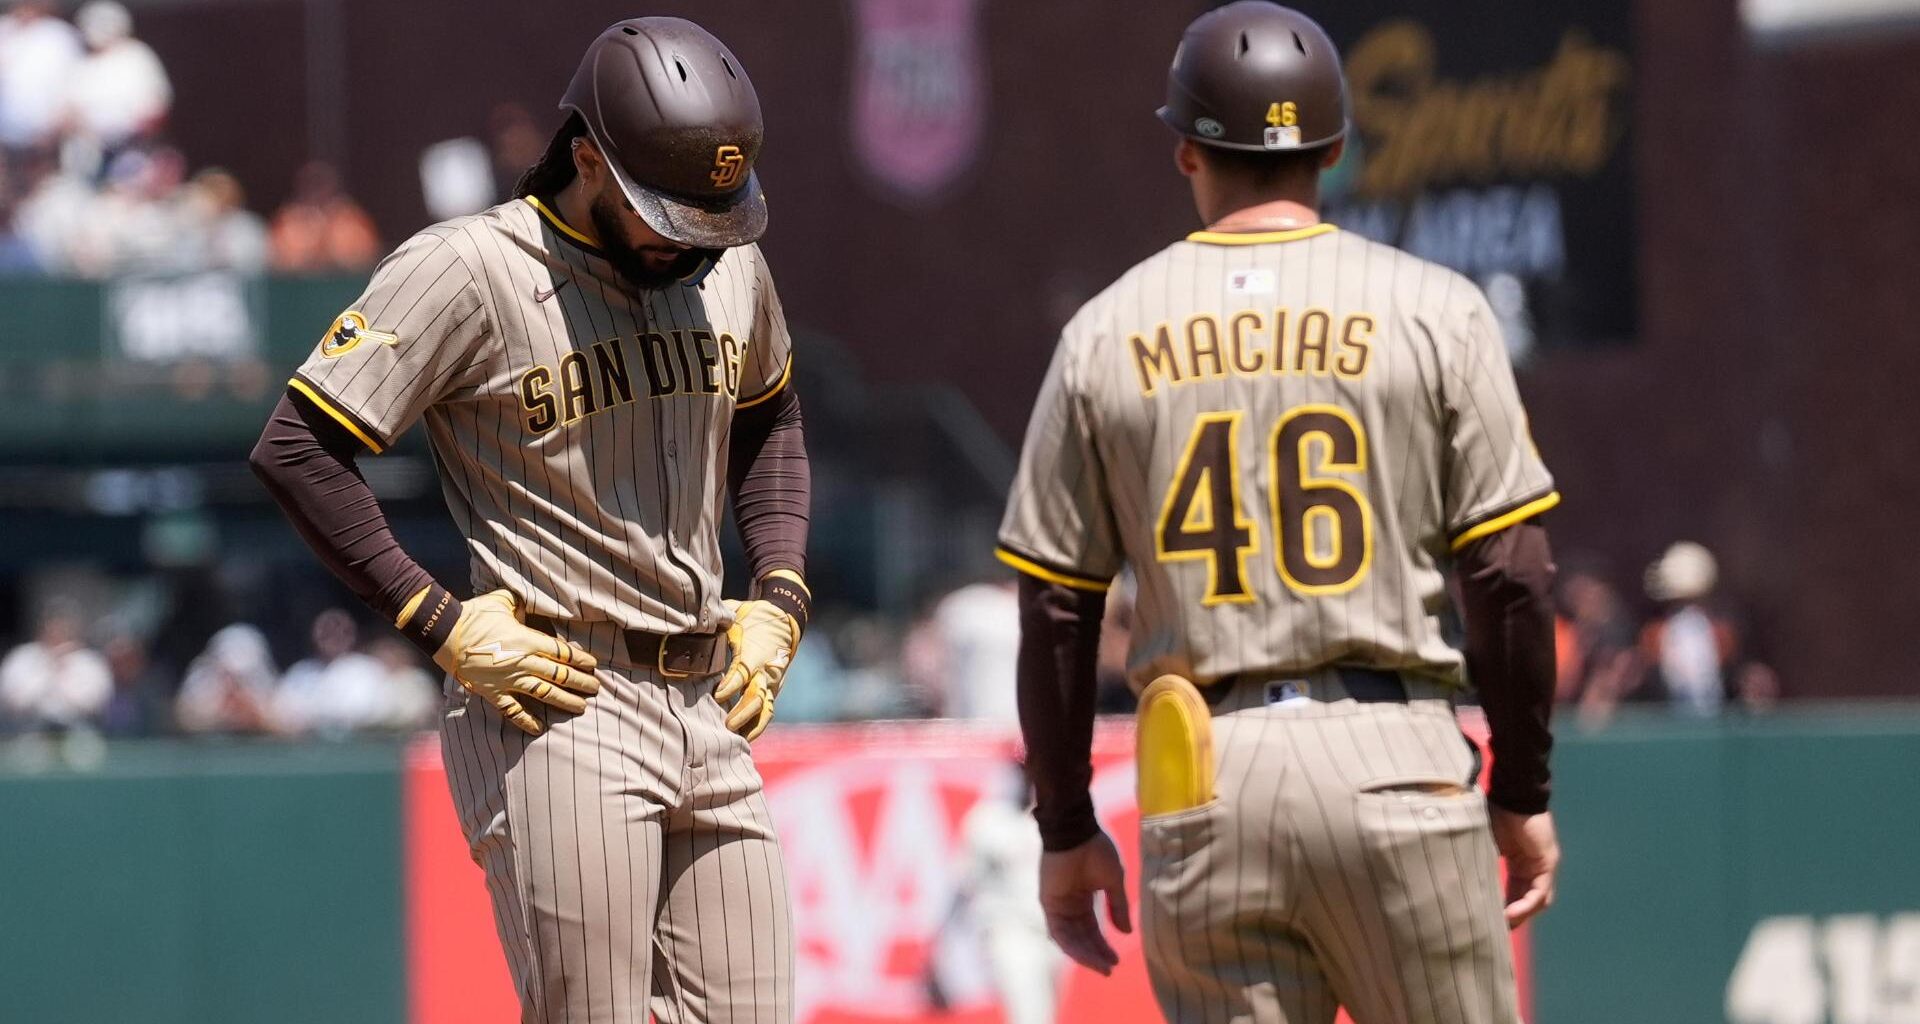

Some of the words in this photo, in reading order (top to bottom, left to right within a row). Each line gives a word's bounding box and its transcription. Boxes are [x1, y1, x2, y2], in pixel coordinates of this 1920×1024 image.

[1265, 101, 1297, 127] 46
[711, 146, 744, 187] SD
[521, 336, 637, 435] SAN
[1129, 307, 1377, 397] MACIAS
[1154, 402, 1376, 606] 46
